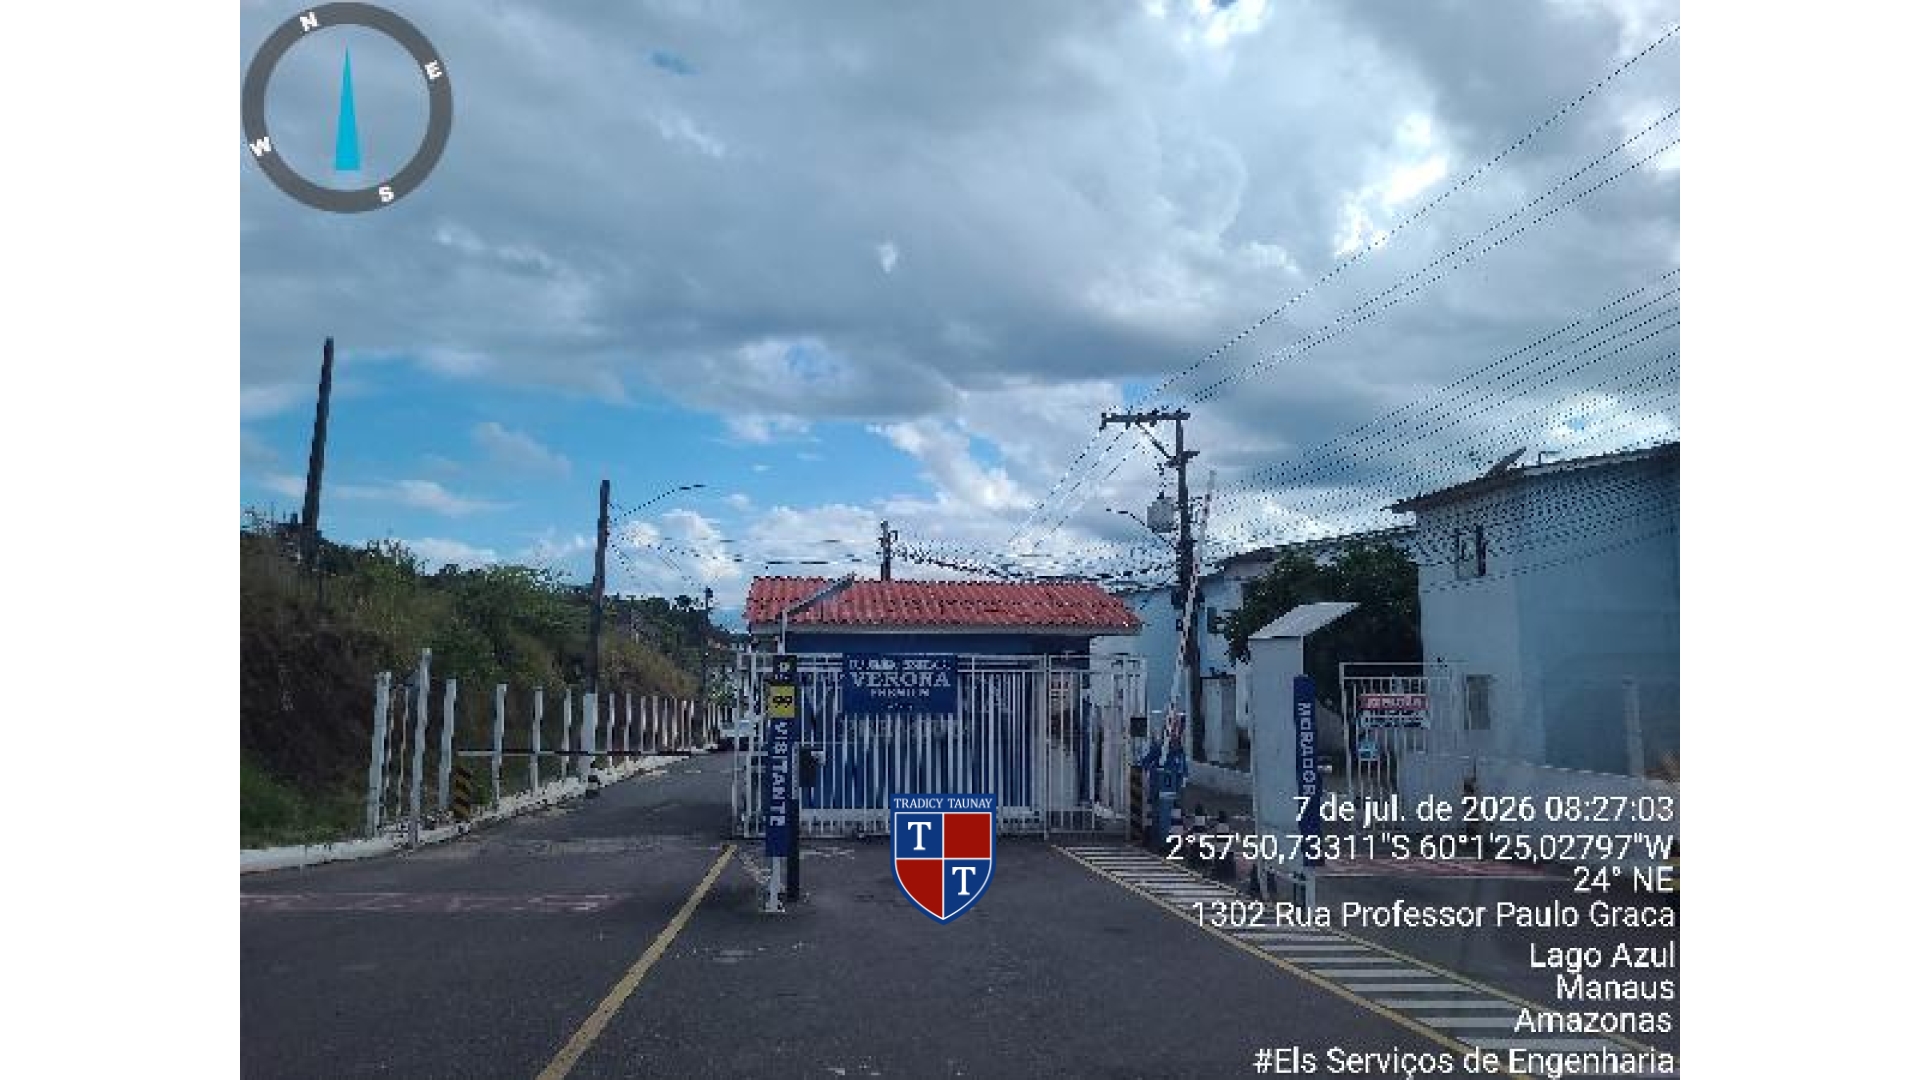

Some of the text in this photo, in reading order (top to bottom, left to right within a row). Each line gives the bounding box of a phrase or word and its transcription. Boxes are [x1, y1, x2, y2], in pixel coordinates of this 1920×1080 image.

[850, 671, 951, 687] VERONA
[770, 721, 789, 827] VISITANTE
[1298, 702, 1316, 796] MORADOR
